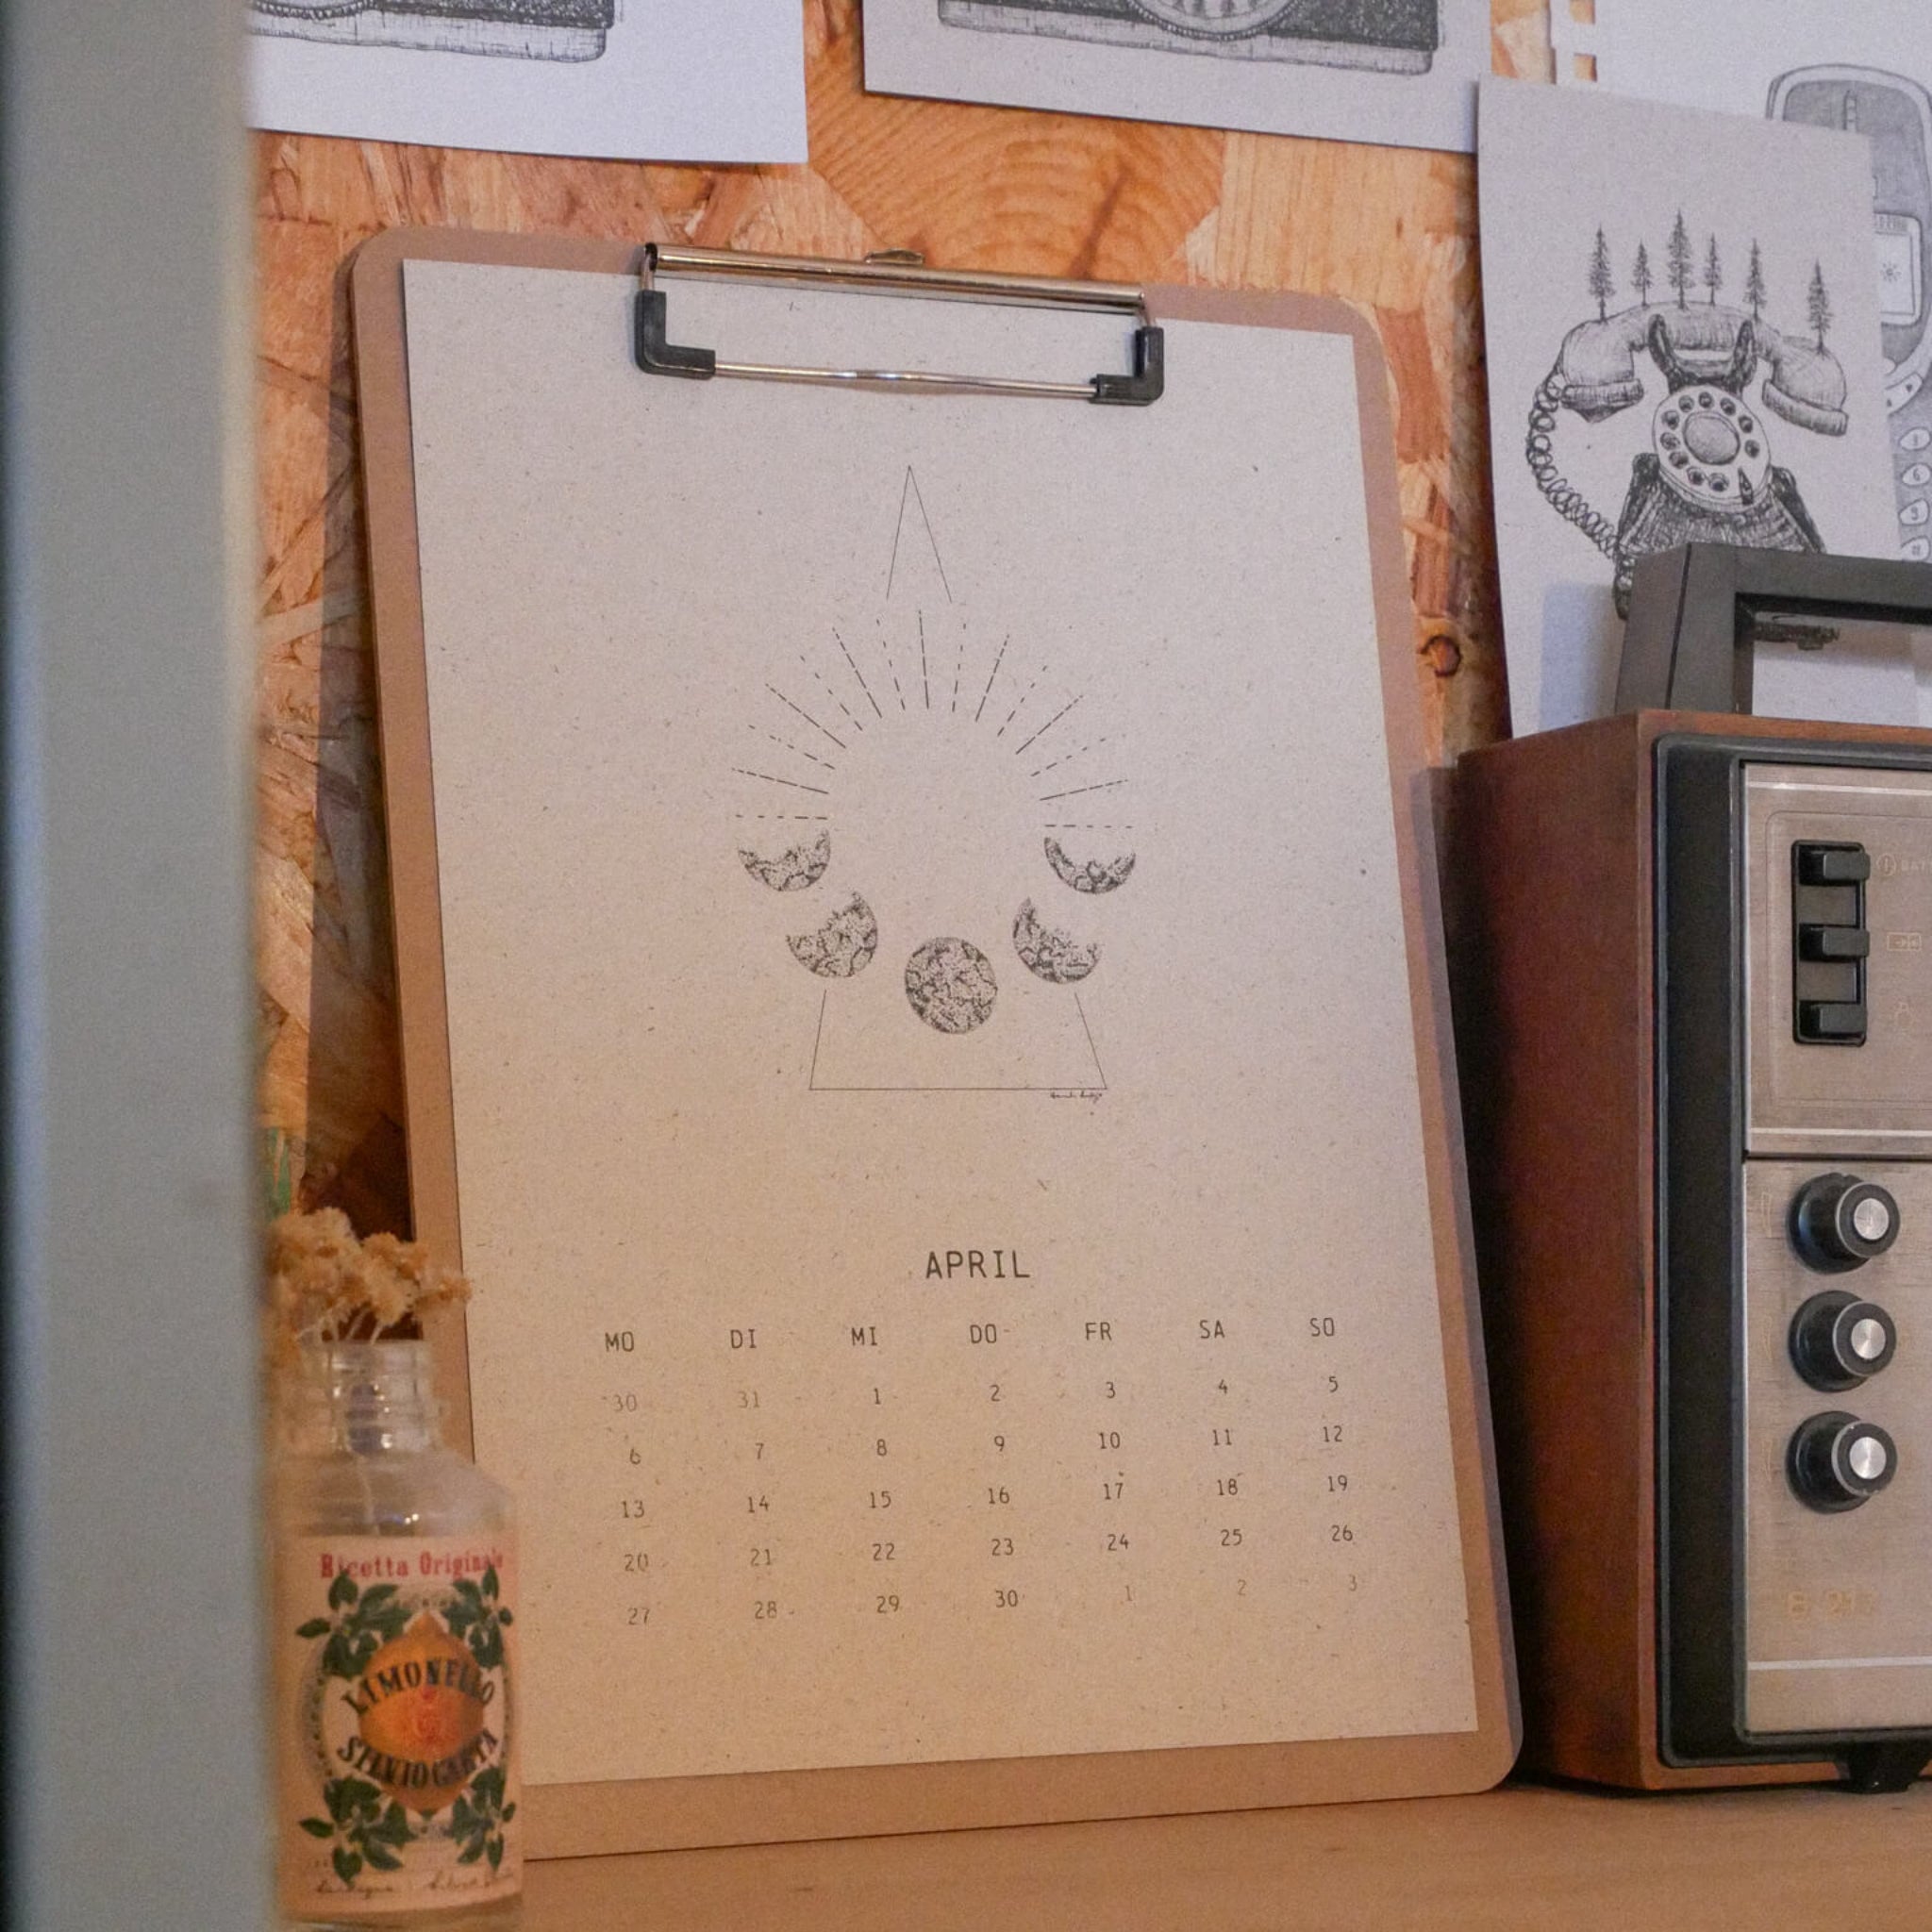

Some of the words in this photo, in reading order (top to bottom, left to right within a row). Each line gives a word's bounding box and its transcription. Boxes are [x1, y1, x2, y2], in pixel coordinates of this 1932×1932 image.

[925, 1250, 1030, 1279] APRIL
[605, 1331, 634, 1353] MO
[730, 1329, 757, 1349] DI
[852, 1326, 877, 1346] MI
[970, 1324, 997, 1344] DO
[1085, 1322, 1112, 1341] FR
[1200, 1320, 1225, 1339] SA
[1310, 1317, 1335, 1337] SO
[613, 1395, 638, 1412] 30
[739, 1391, 759, 1408] 31
[874, 1389, 881, 1405] 1
[991, 1385, 1000, 1402] 2
[1106, 1382, 1115, 1398] 3
[1218, 1379, 1227, 1394] 4
[1328, 1376, 1338, 1392] 5
[630, 1449, 641, 1464] 6
[756, 1443, 764, 1459] 7
[876, 1439, 887, 1457] 8
[994, 1436, 1005, 1452] 9
[1099, 1432, 1121, 1449] 10
[1212, 1429, 1233, 1446] 11
[1322, 1425, 1342, 1442] 12
[622, 1501, 644, 1519] 13
[747, 1496, 770, 1513] 14
[869, 1491, 891, 1508] 15
[988, 1488, 1009, 1505] 16
[1104, 1483, 1124, 1499] 17
[1217, 1479, 1238, 1496] 18
[1327, 1475, 1348, 1492] 19
[625, 1554, 648, 1572] 20
[750, 1549, 772, 1567] 21
[873, 1543, 895, 1561] 22
[991, 1539, 1014, 1557] 23
[1108, 1535, 1129, 1551] 24
[1221, 1529, 1242, 1546] 25
[1331, 1524, 1353, 1541] 26
[628, 1607, 650, 1625] 27
[755, 1601, 777, 1619] 28
[876, 1595, 900, 1613] 29
[995, 1591, 1018, 1607] 30
[1125, 1586, 1132, 1602] 1
[1238, 1580, 1247, 1596] 2
[1349, 1575, 1357, 1592] 3
